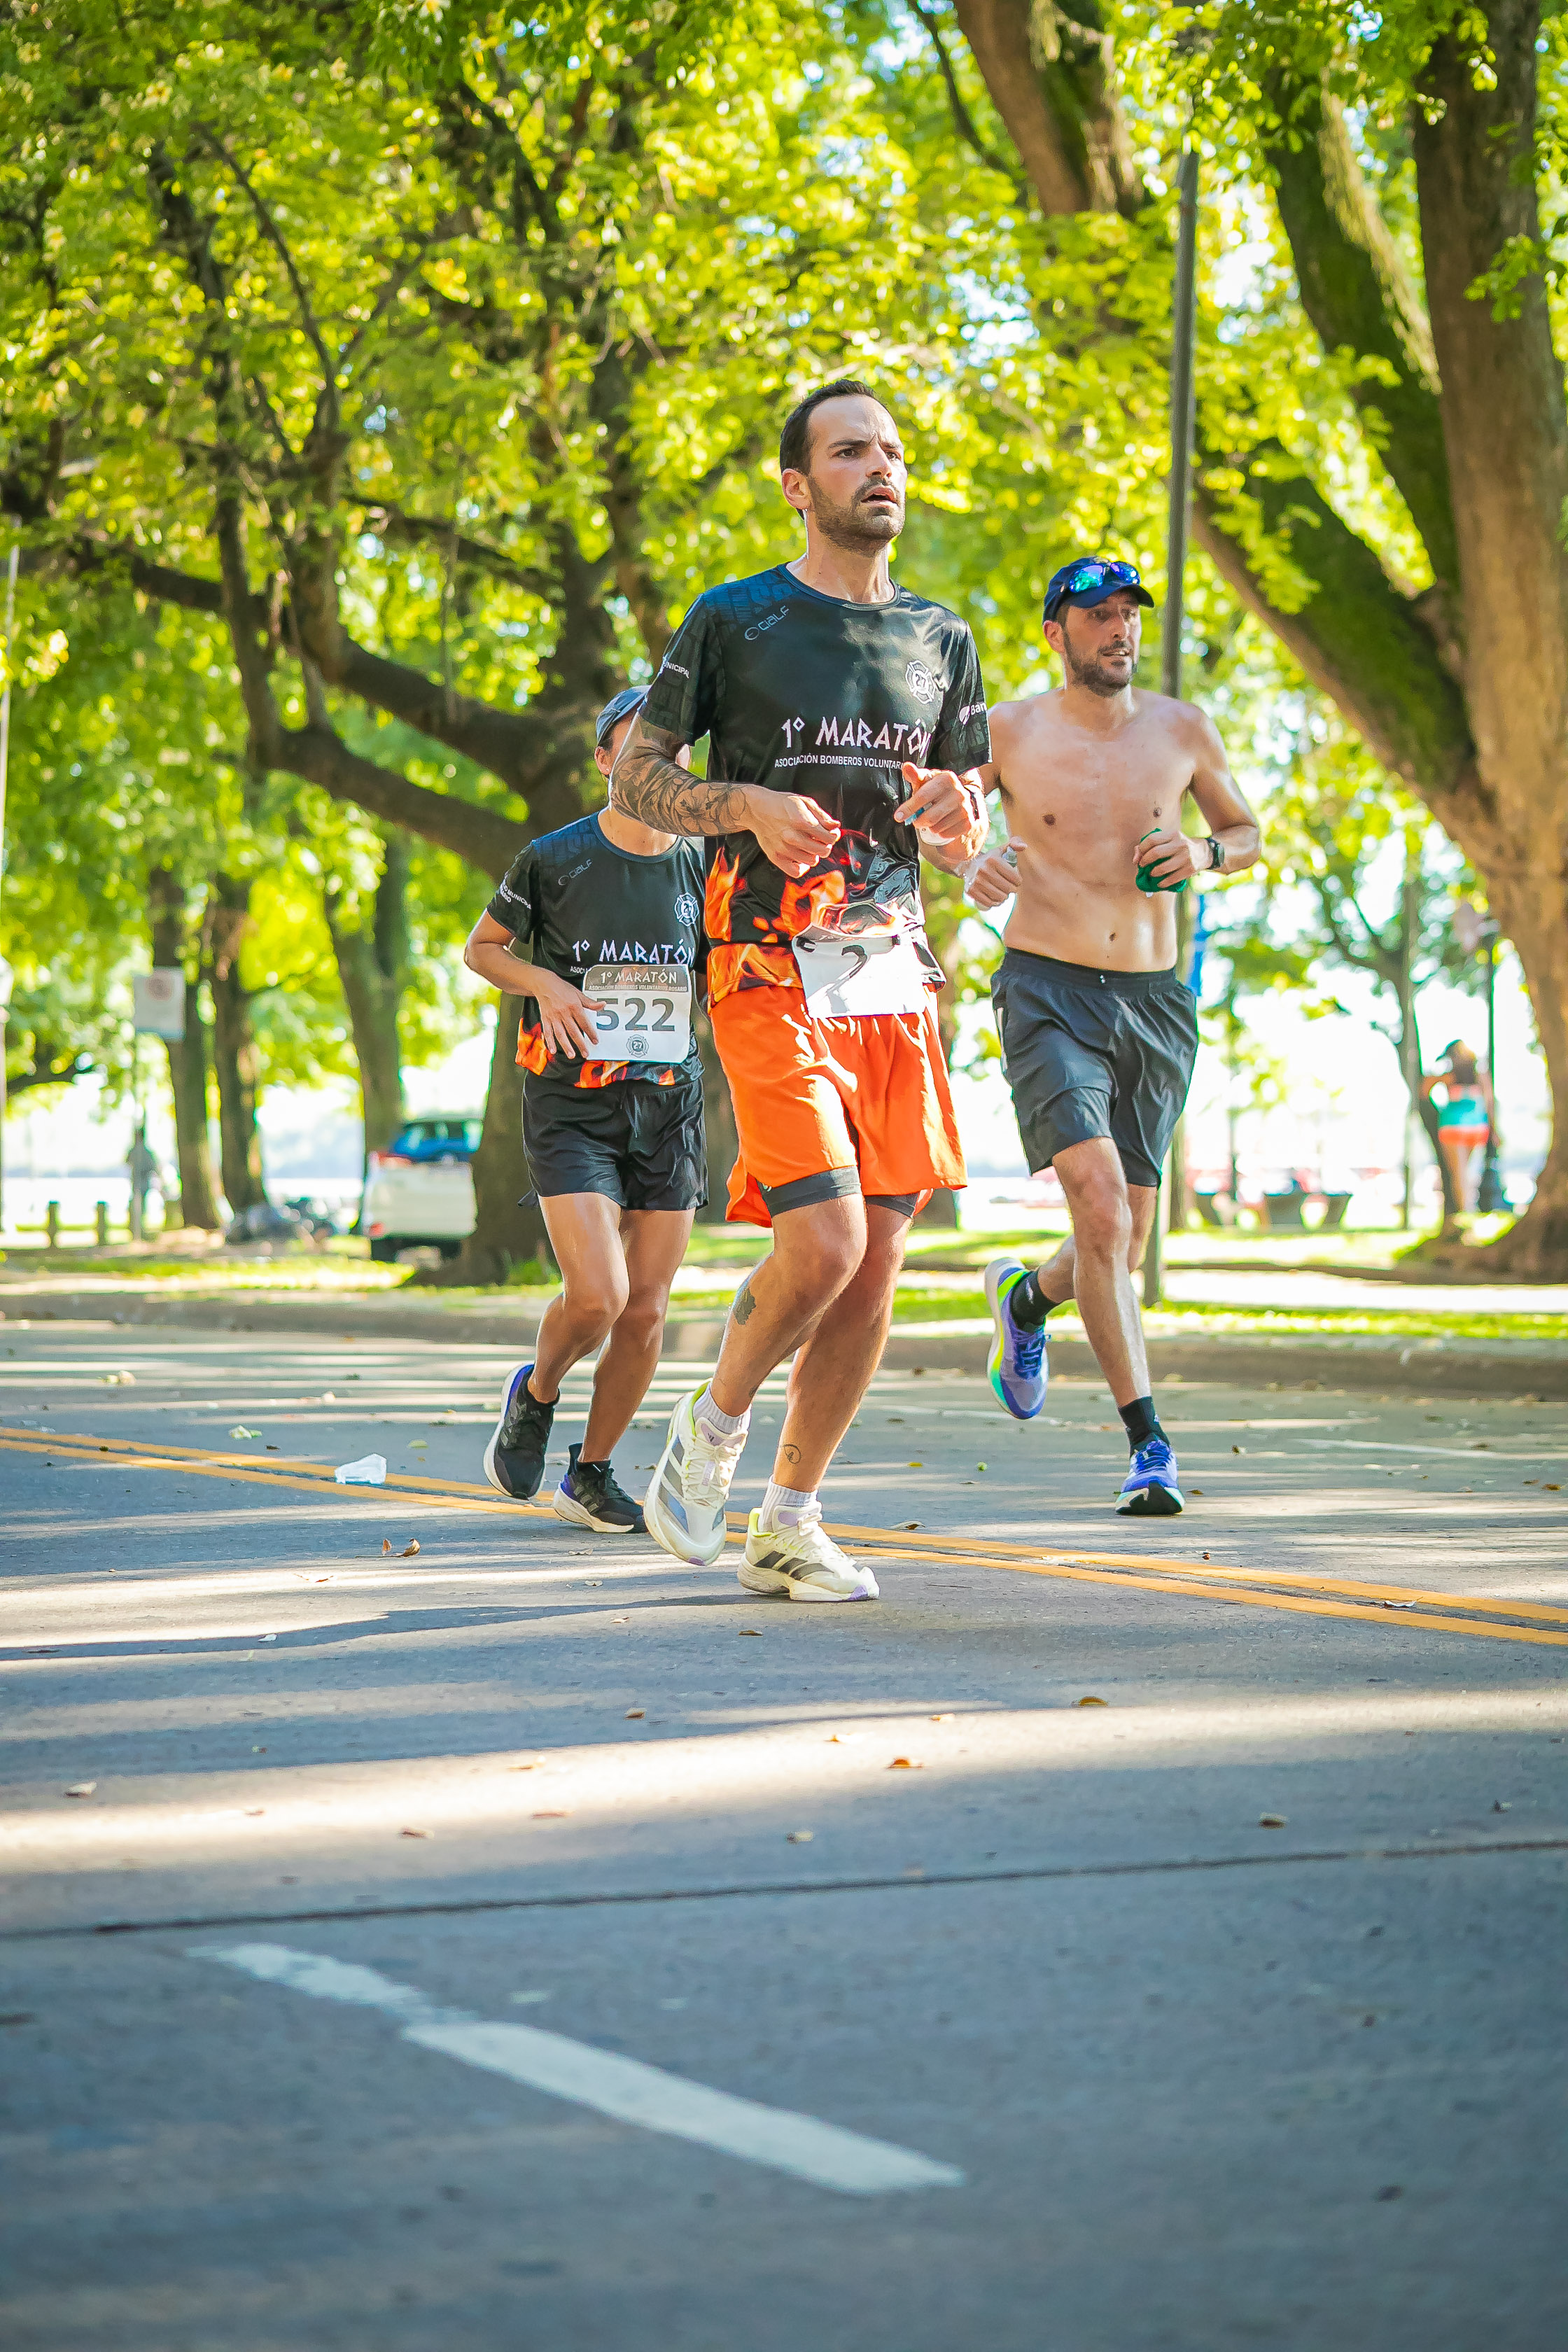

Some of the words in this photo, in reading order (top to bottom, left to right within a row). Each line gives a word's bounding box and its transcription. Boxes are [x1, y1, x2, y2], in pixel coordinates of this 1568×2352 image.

[970, 702, 987, 716] Ban
[816, 716, 932, 759] MARATÓN
[774, 752, 818, 768] ASOCIACIÓN
[820, 755, 862, 766] BOMBEROS
[863, 757, 903, 770] VOLUNTARI
[599, 938, 695, 968] MARATÓN
[614, 968, 677, 984] MARATÓN
[596, 997, 675, 1032] 522
